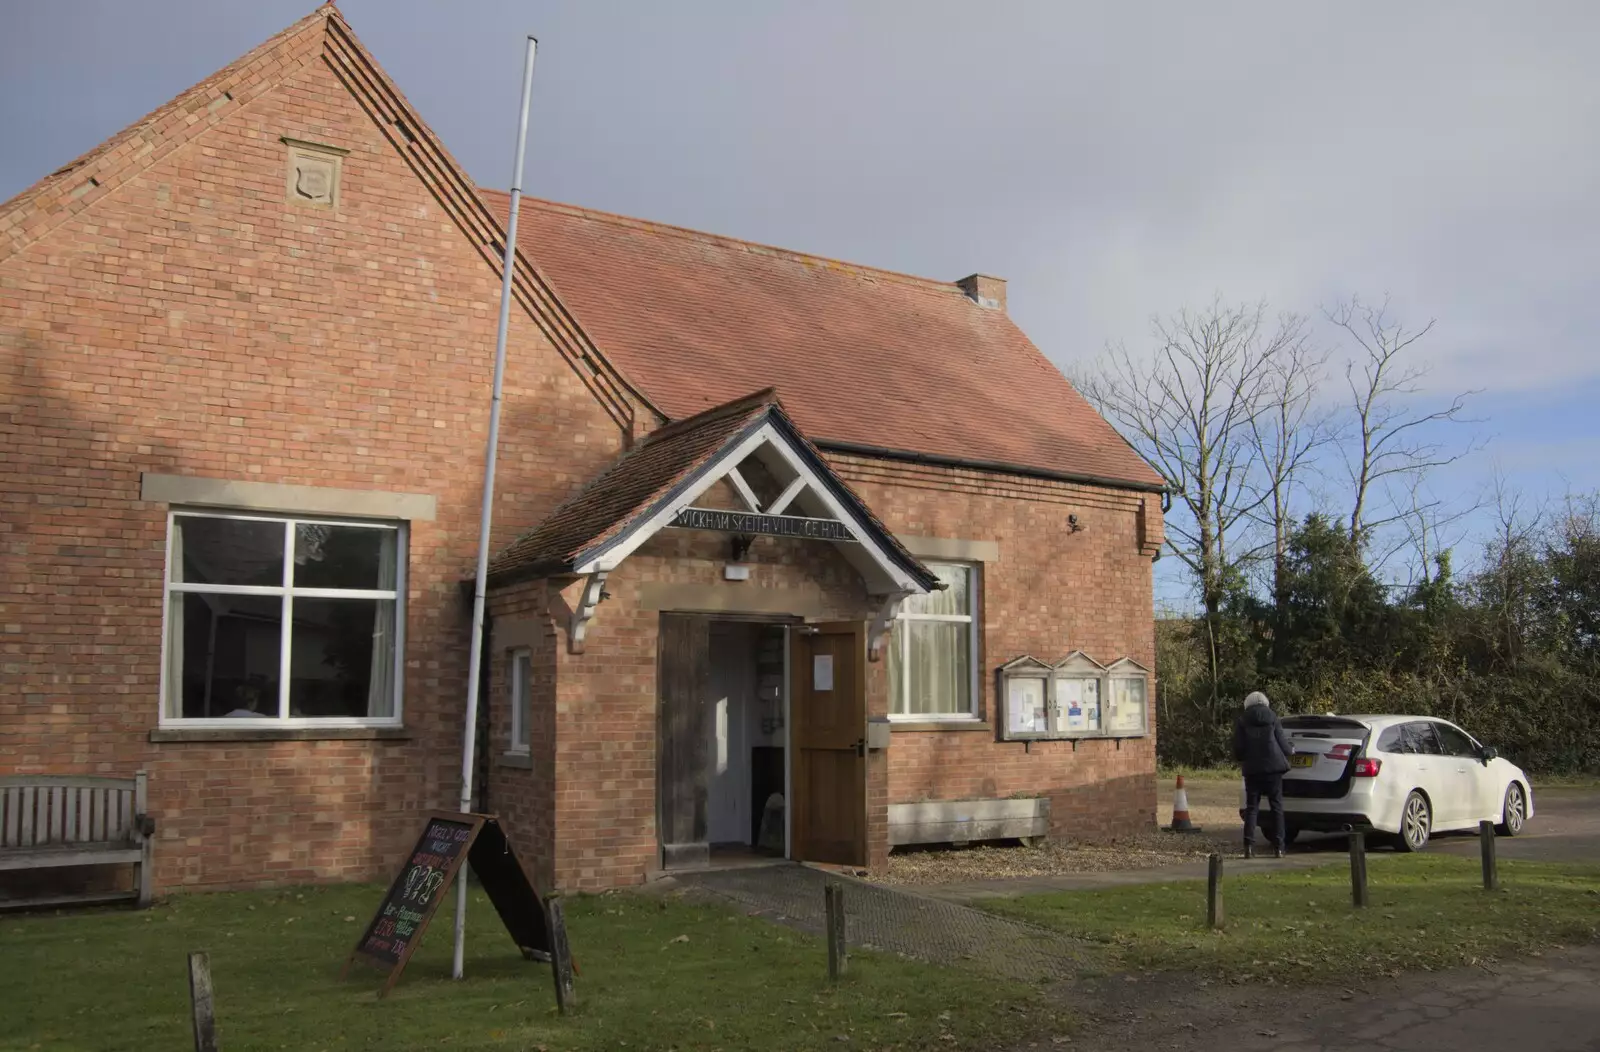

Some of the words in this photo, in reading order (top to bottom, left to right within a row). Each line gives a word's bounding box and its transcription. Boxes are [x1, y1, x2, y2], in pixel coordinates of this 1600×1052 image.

[677, 510, 729, 529] WICKHAM
[732, 514, 770, 533] SKEITH
[822, 522, 850, 540] HALL
